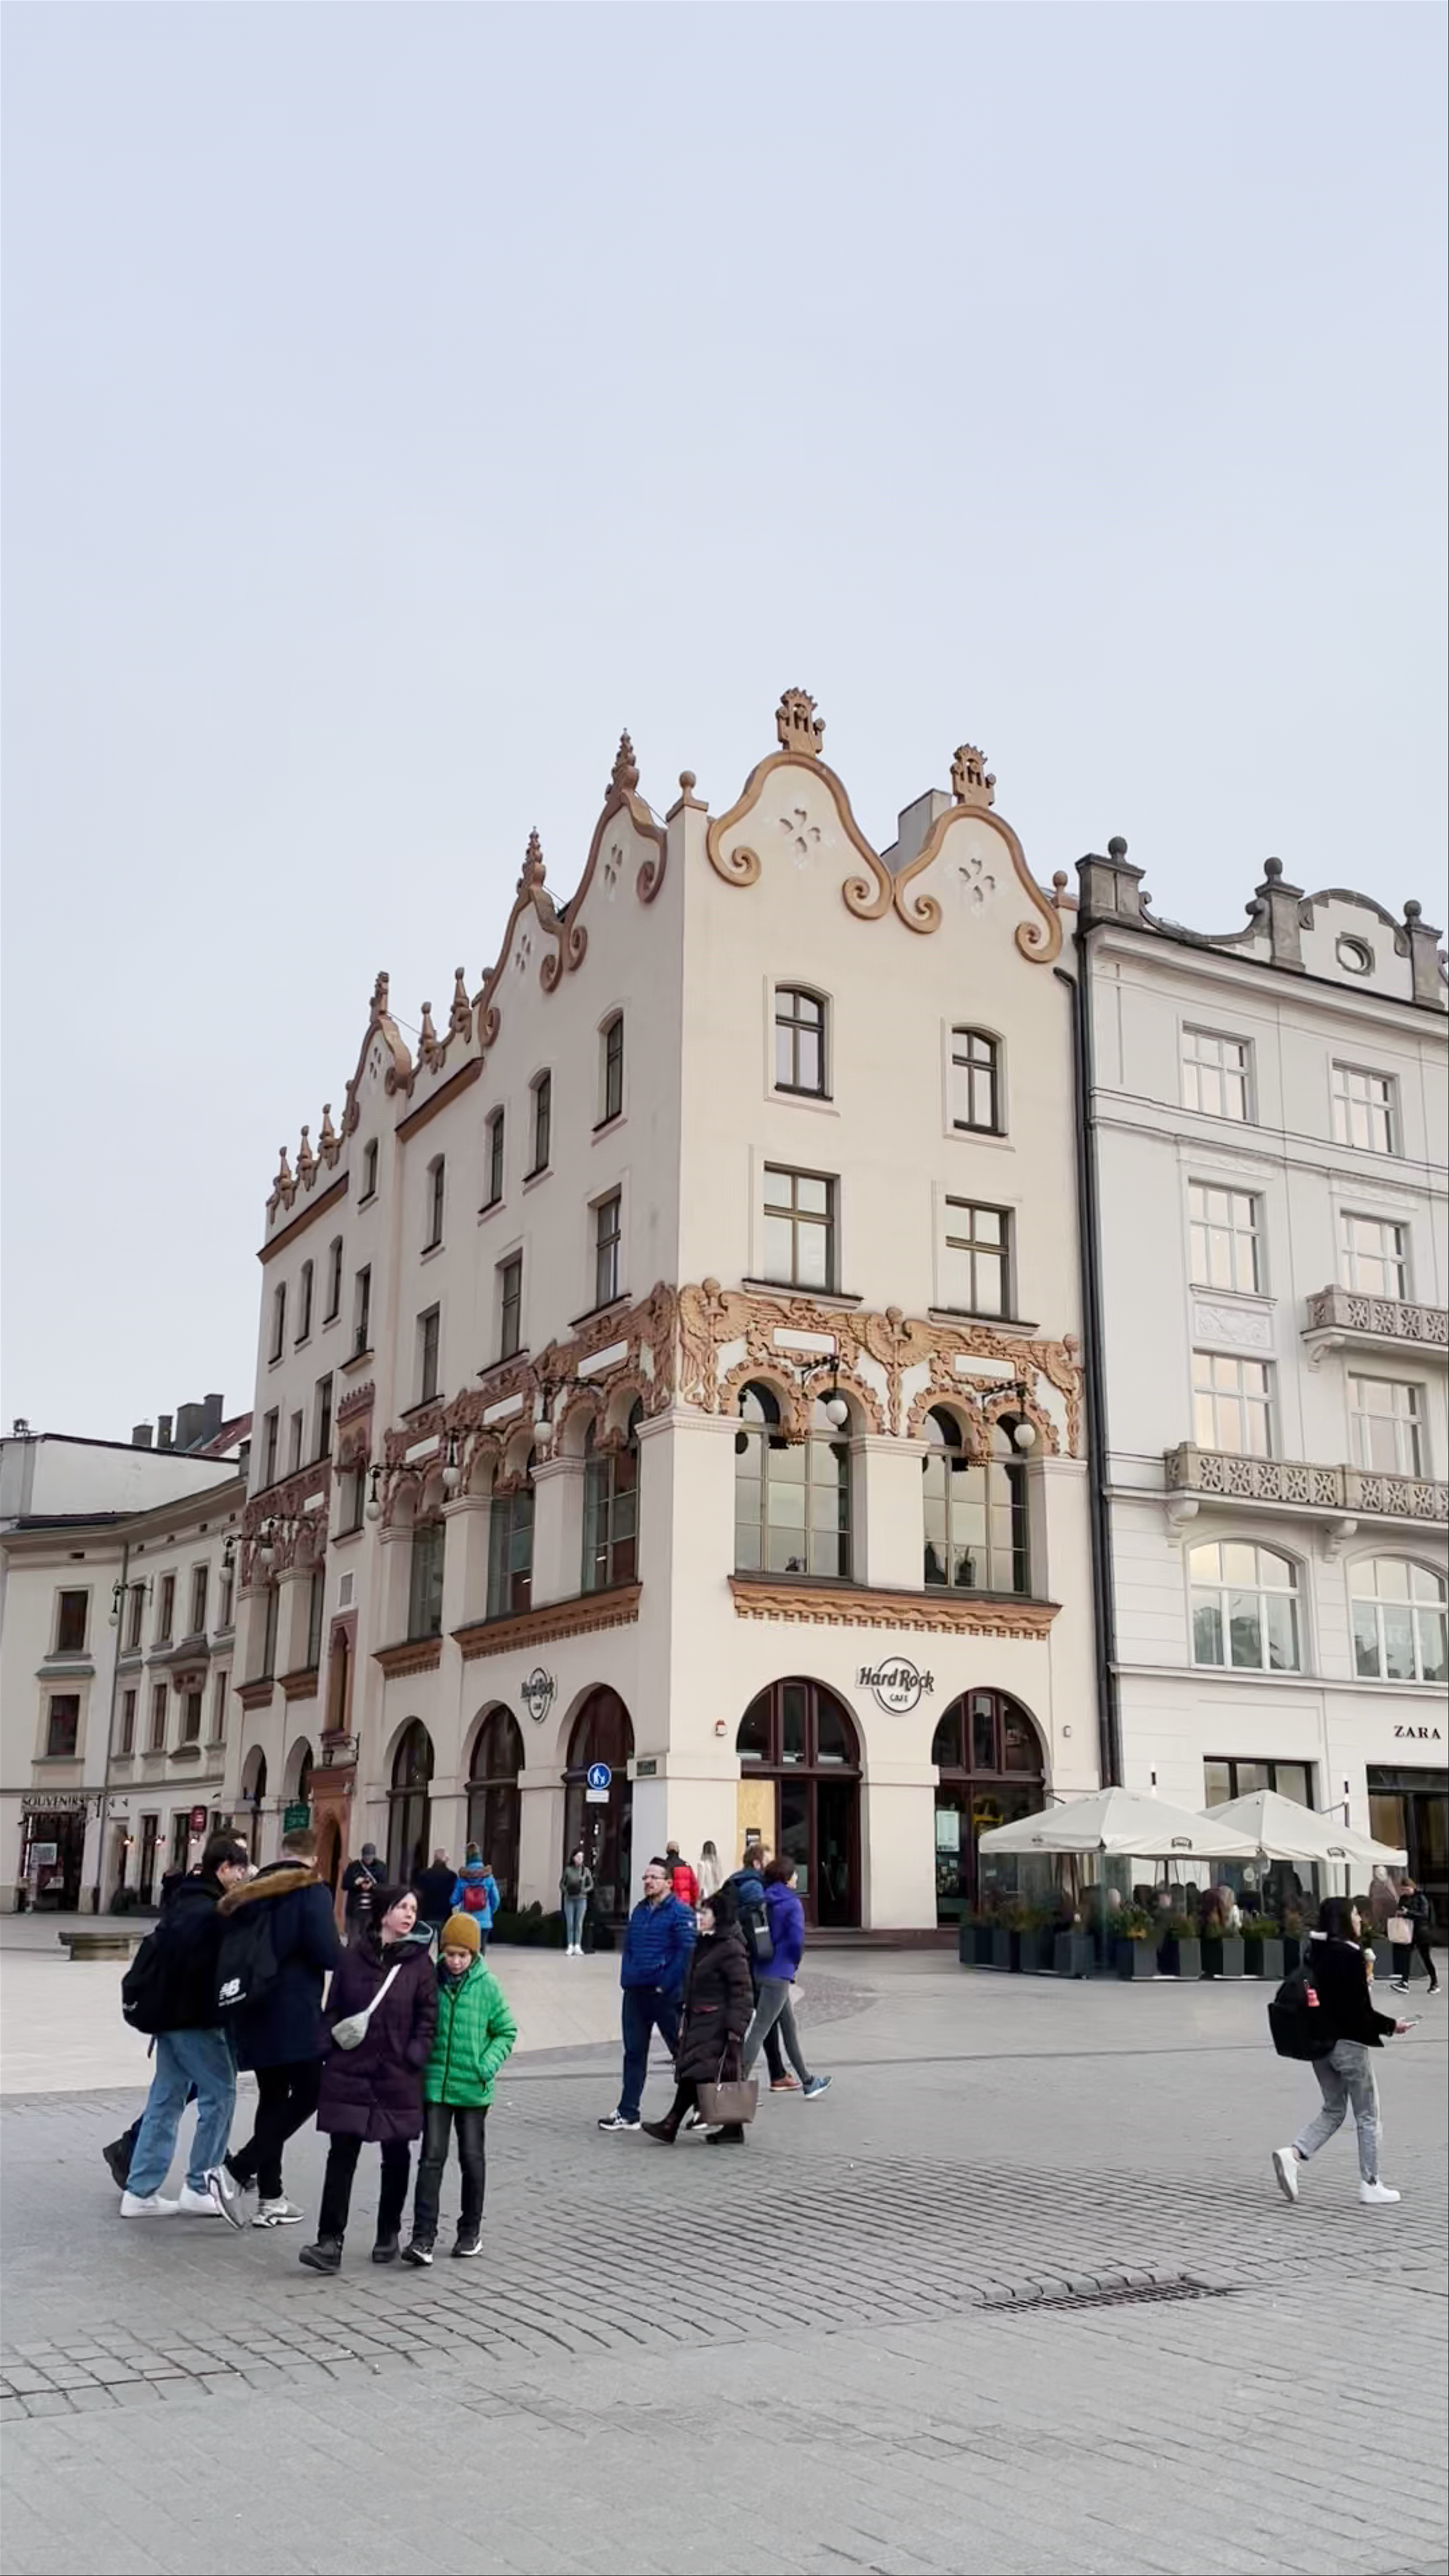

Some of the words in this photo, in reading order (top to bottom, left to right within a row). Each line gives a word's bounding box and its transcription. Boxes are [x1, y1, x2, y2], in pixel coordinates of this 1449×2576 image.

[860, 1667, 898, 1686] Hard
[899, 1669, 934, 1692] Rock
[1394, 1725, 1441, 1739] ZARA
